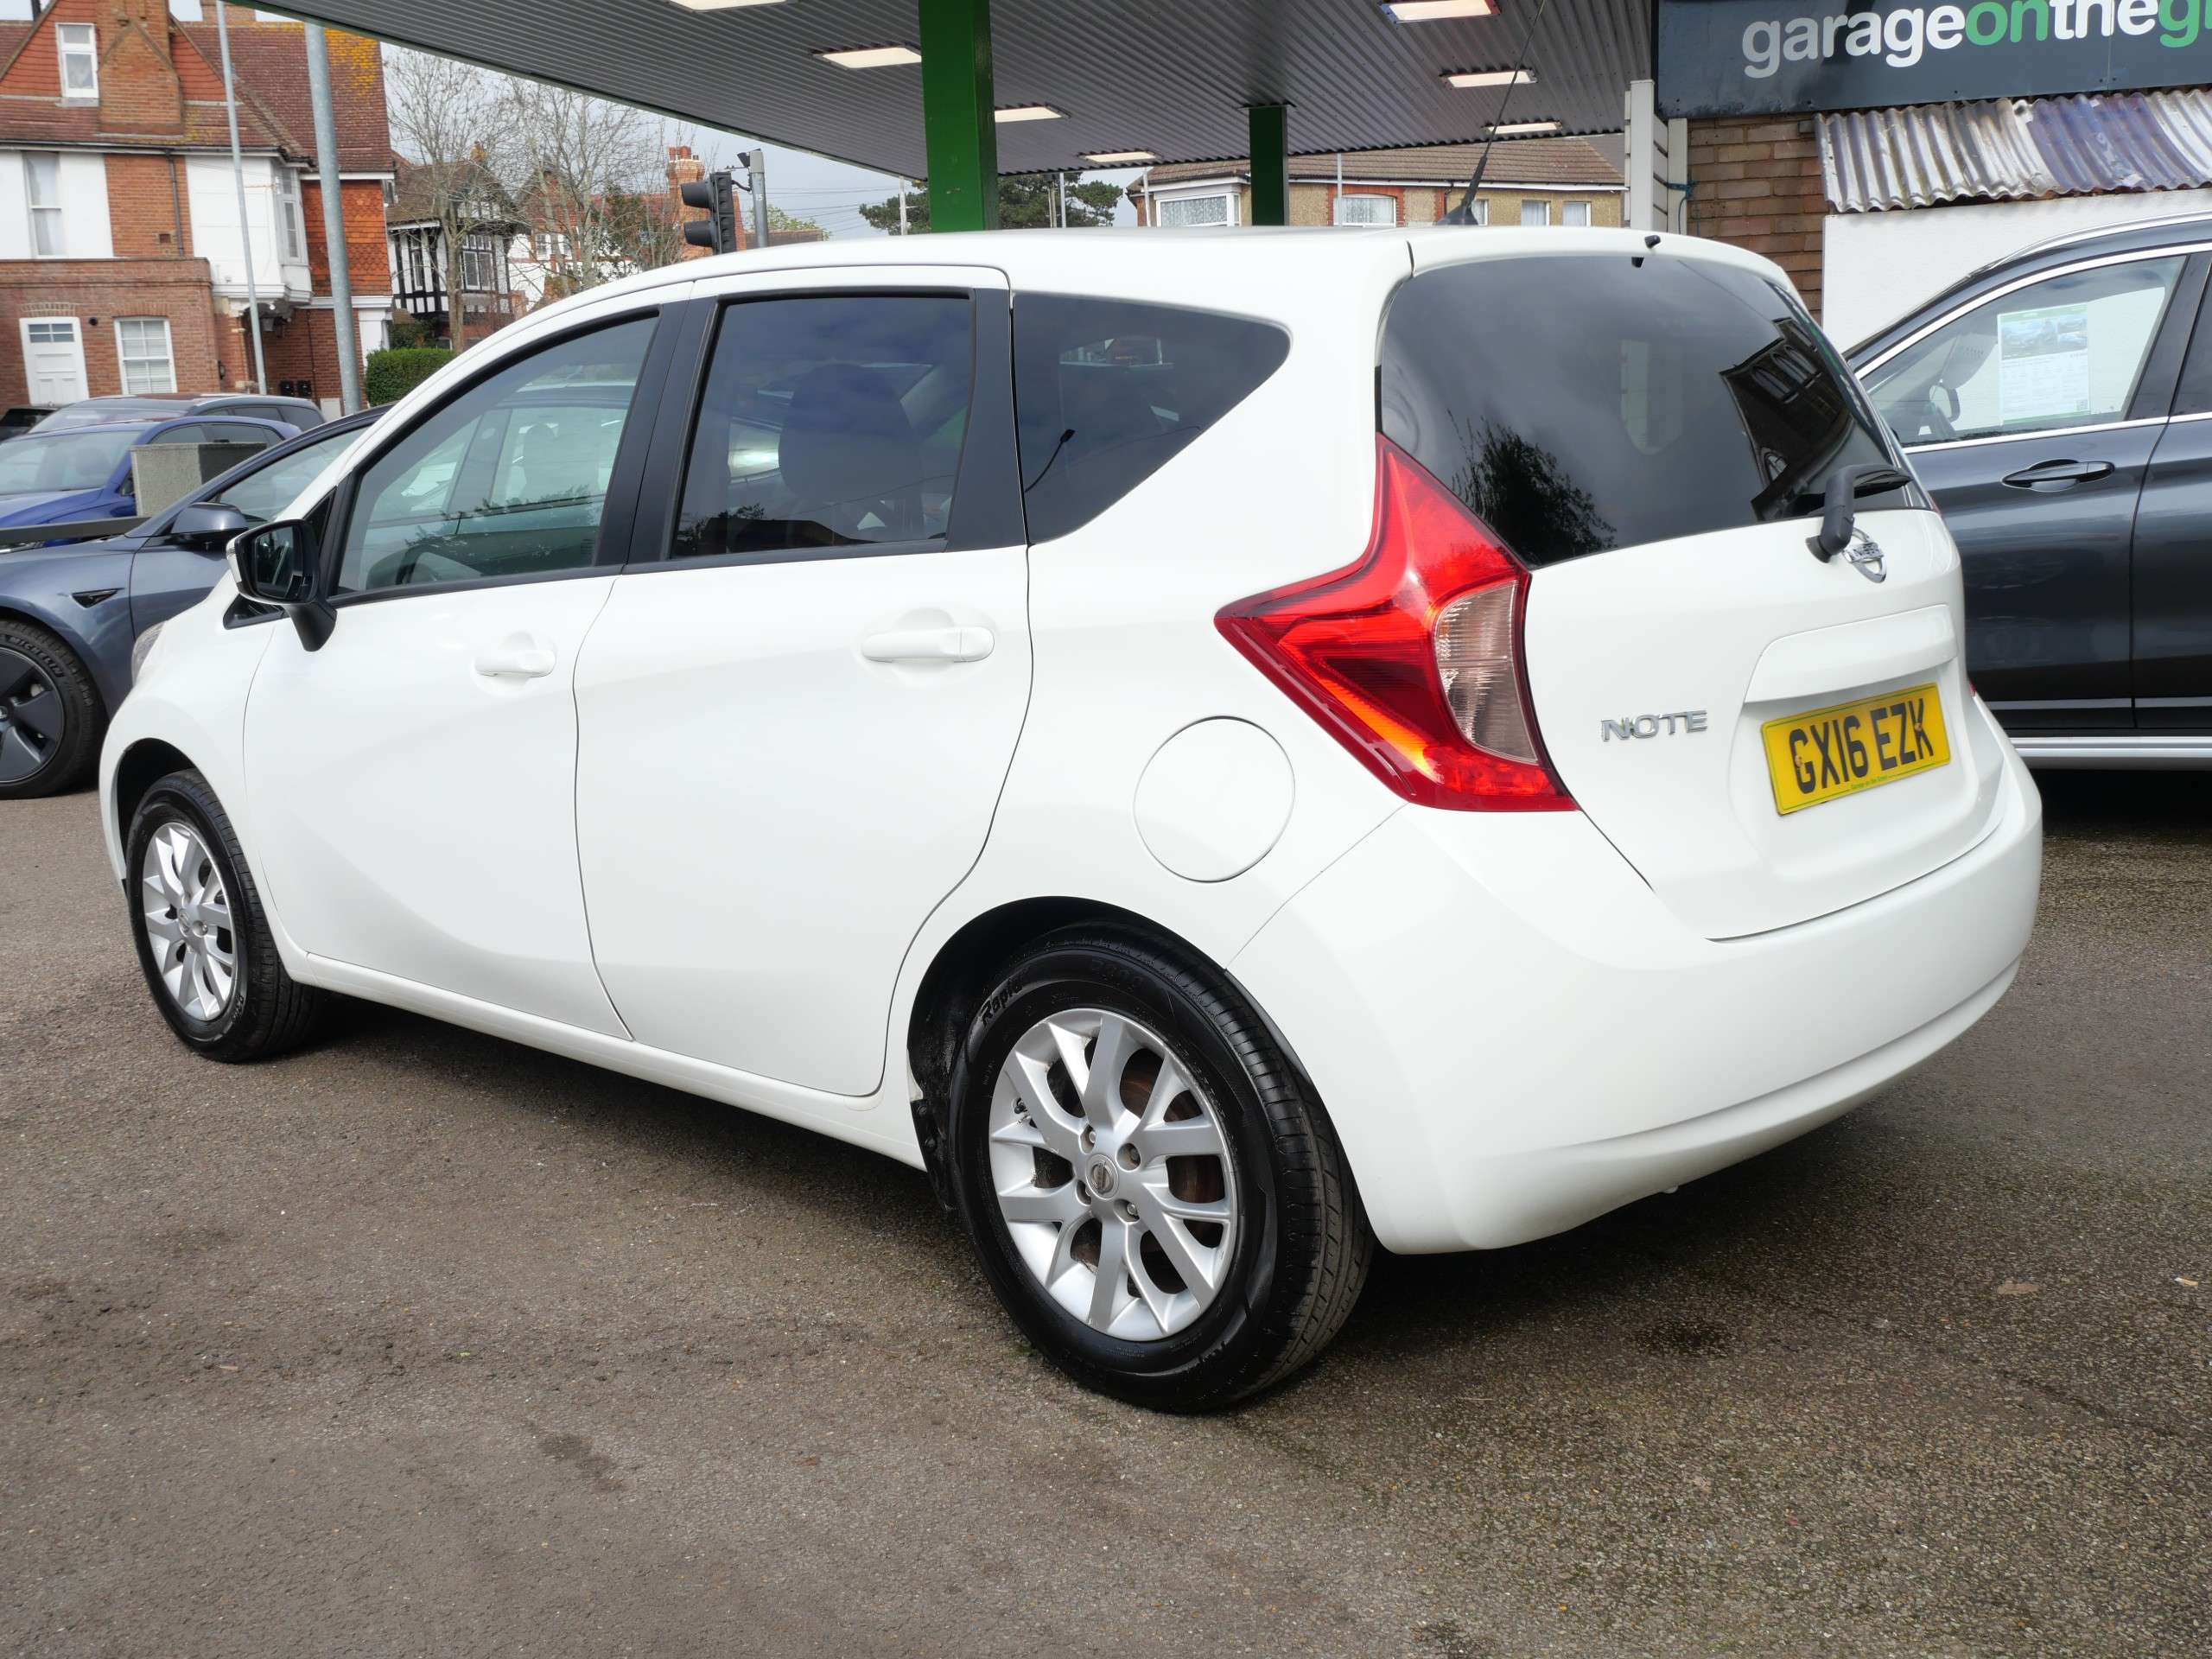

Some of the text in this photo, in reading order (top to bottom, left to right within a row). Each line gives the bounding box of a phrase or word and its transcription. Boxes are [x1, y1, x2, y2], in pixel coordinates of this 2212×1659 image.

[1742, 0, 2212, 79] garageontheg
[1601, 709, 1708, 742] NOTE
[1789, 697, 1935, 795] GX16 EZK
